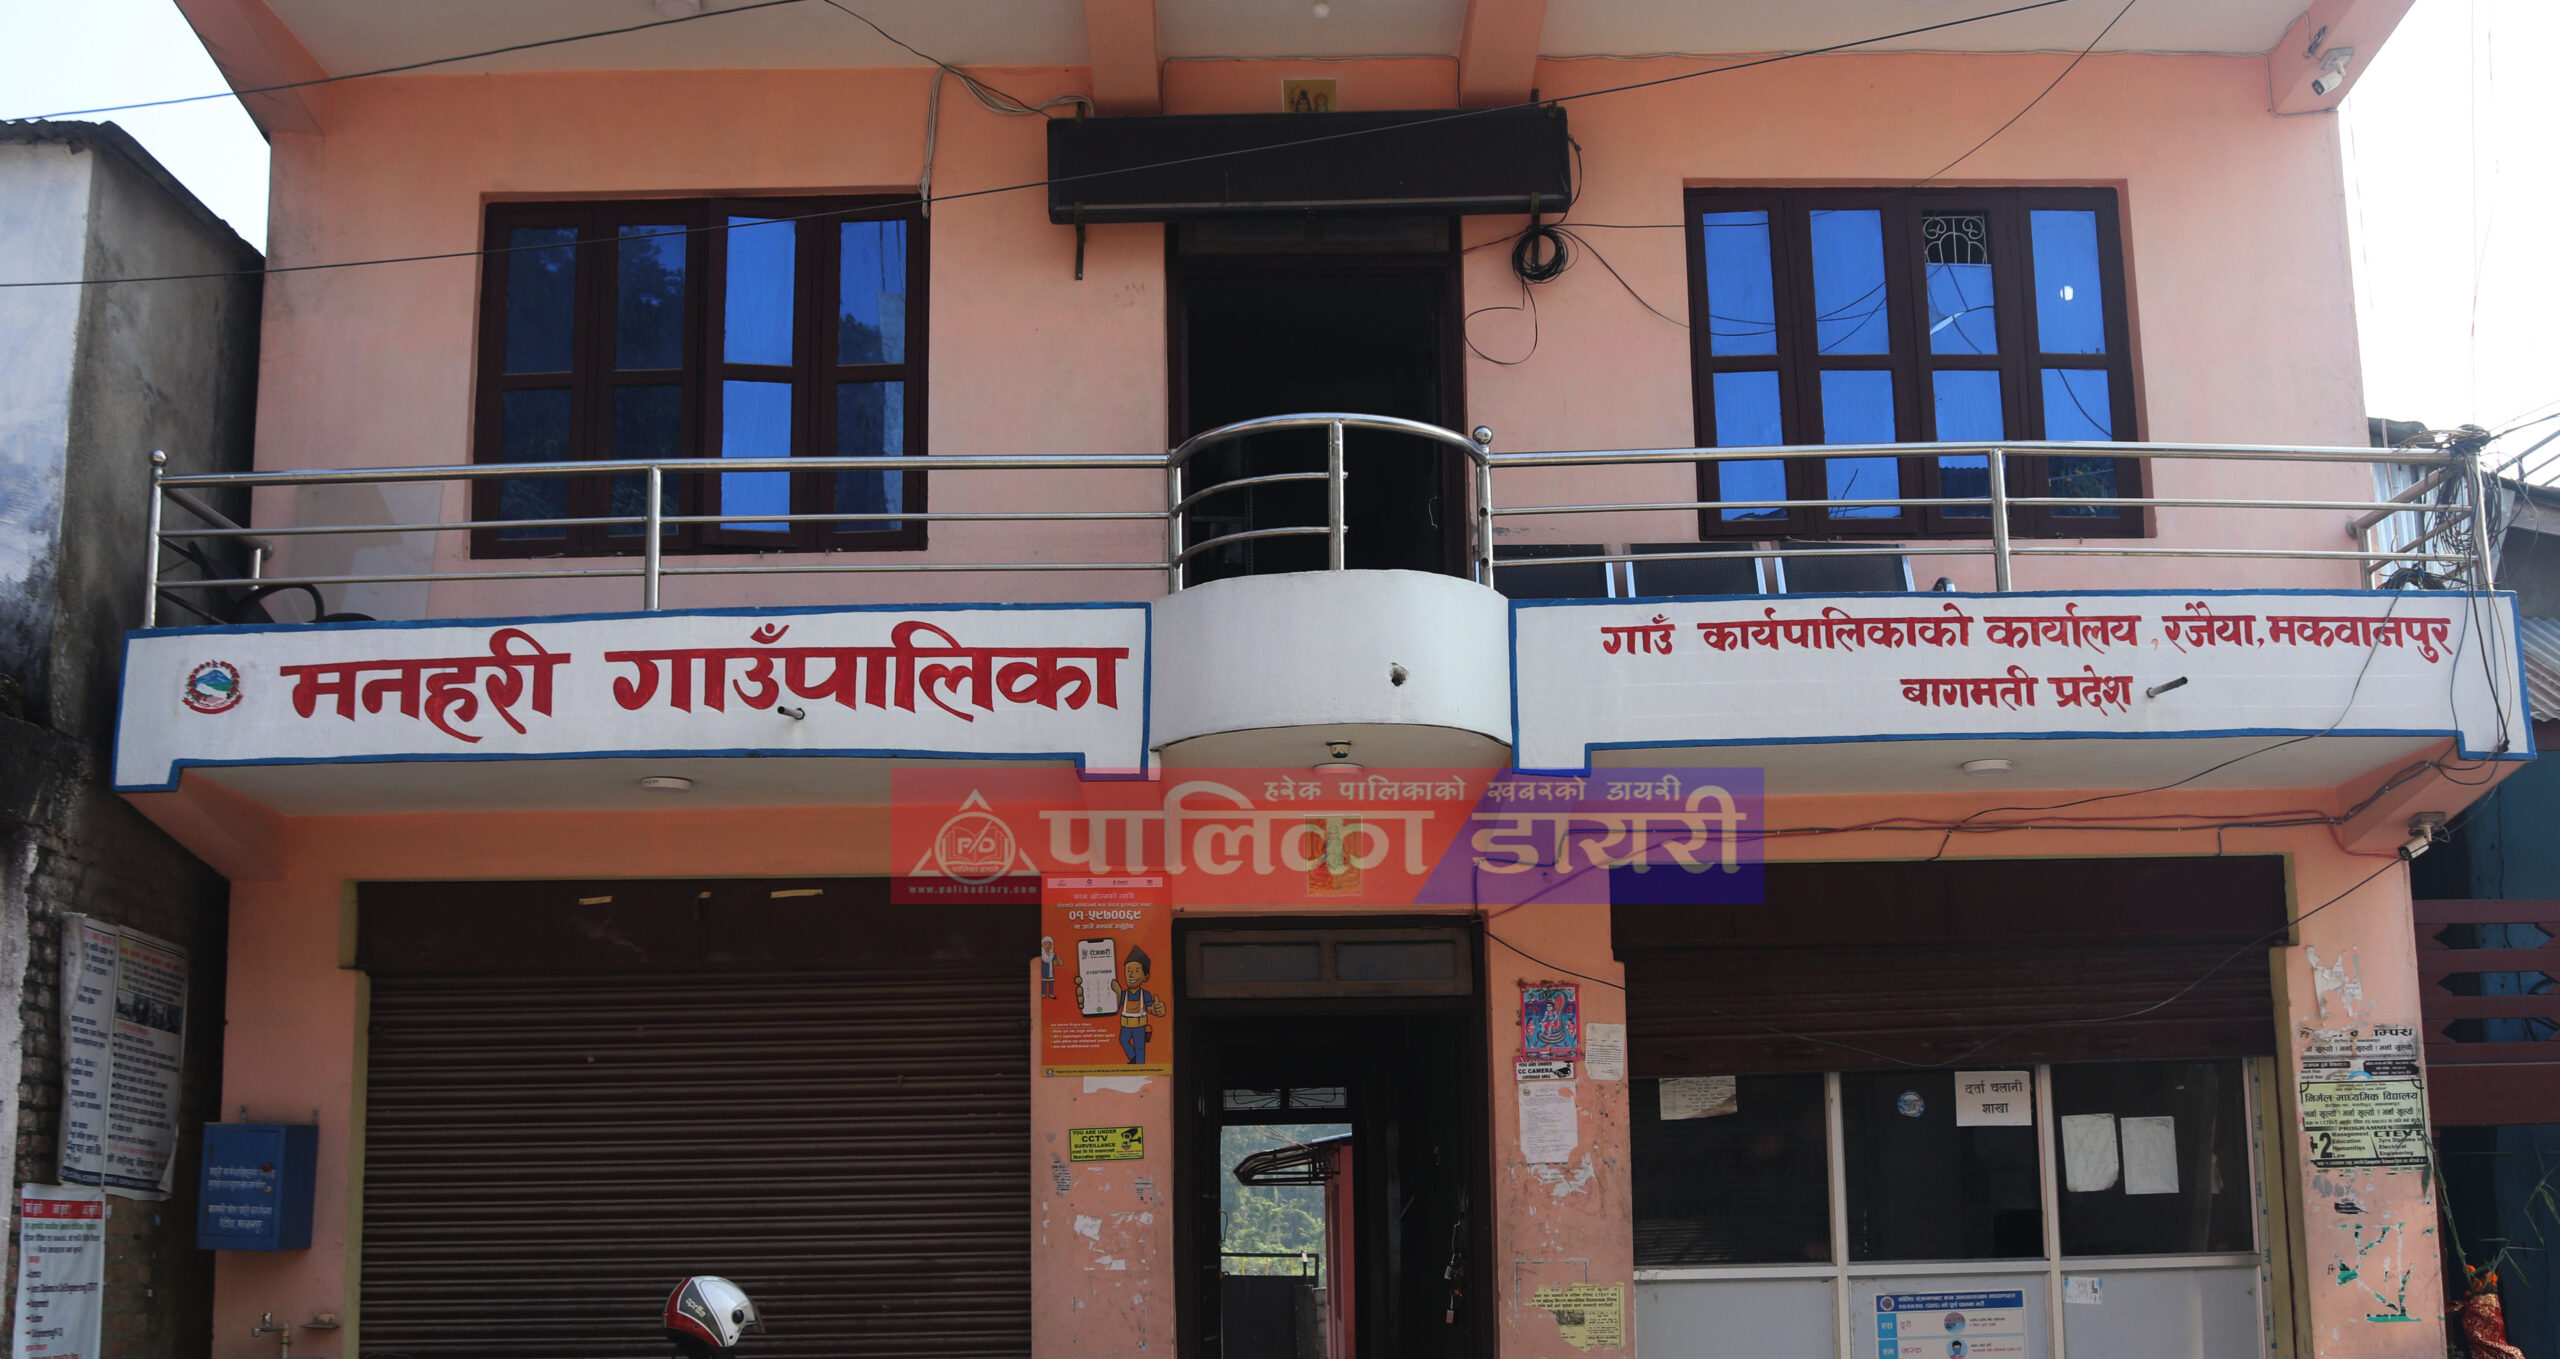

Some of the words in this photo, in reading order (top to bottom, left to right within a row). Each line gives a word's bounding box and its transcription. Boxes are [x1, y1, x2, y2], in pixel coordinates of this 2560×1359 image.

[1601, 613, 1675, 654] गाउँ
[1698, 603, 1973, 652] कार्यपालिकाको
[2266, 615, 2453, 663] मकवानपुर
[281, 628, 571, 742] मनहरी
[605, 622, 1129, 722] गाउँपालिका
[1901, 665, 2038, 711] बागमती
[2048, 665, 2133, 716] प्रदेश
[1964, 1080, 1985, 1095] दर्ता
[1990, 1079, 2023, 1093] चलानी
[2305, 1093, 2333, 1102] निर्मल
[2337, 1092, 2379, 1102] माध्यमिक
[2383, 1091, 2418, 1100] विद्यालय
[1982, 1103, 2009, 1114] शाखा
[2374, 1130, 2422, 1138] CTEVT
